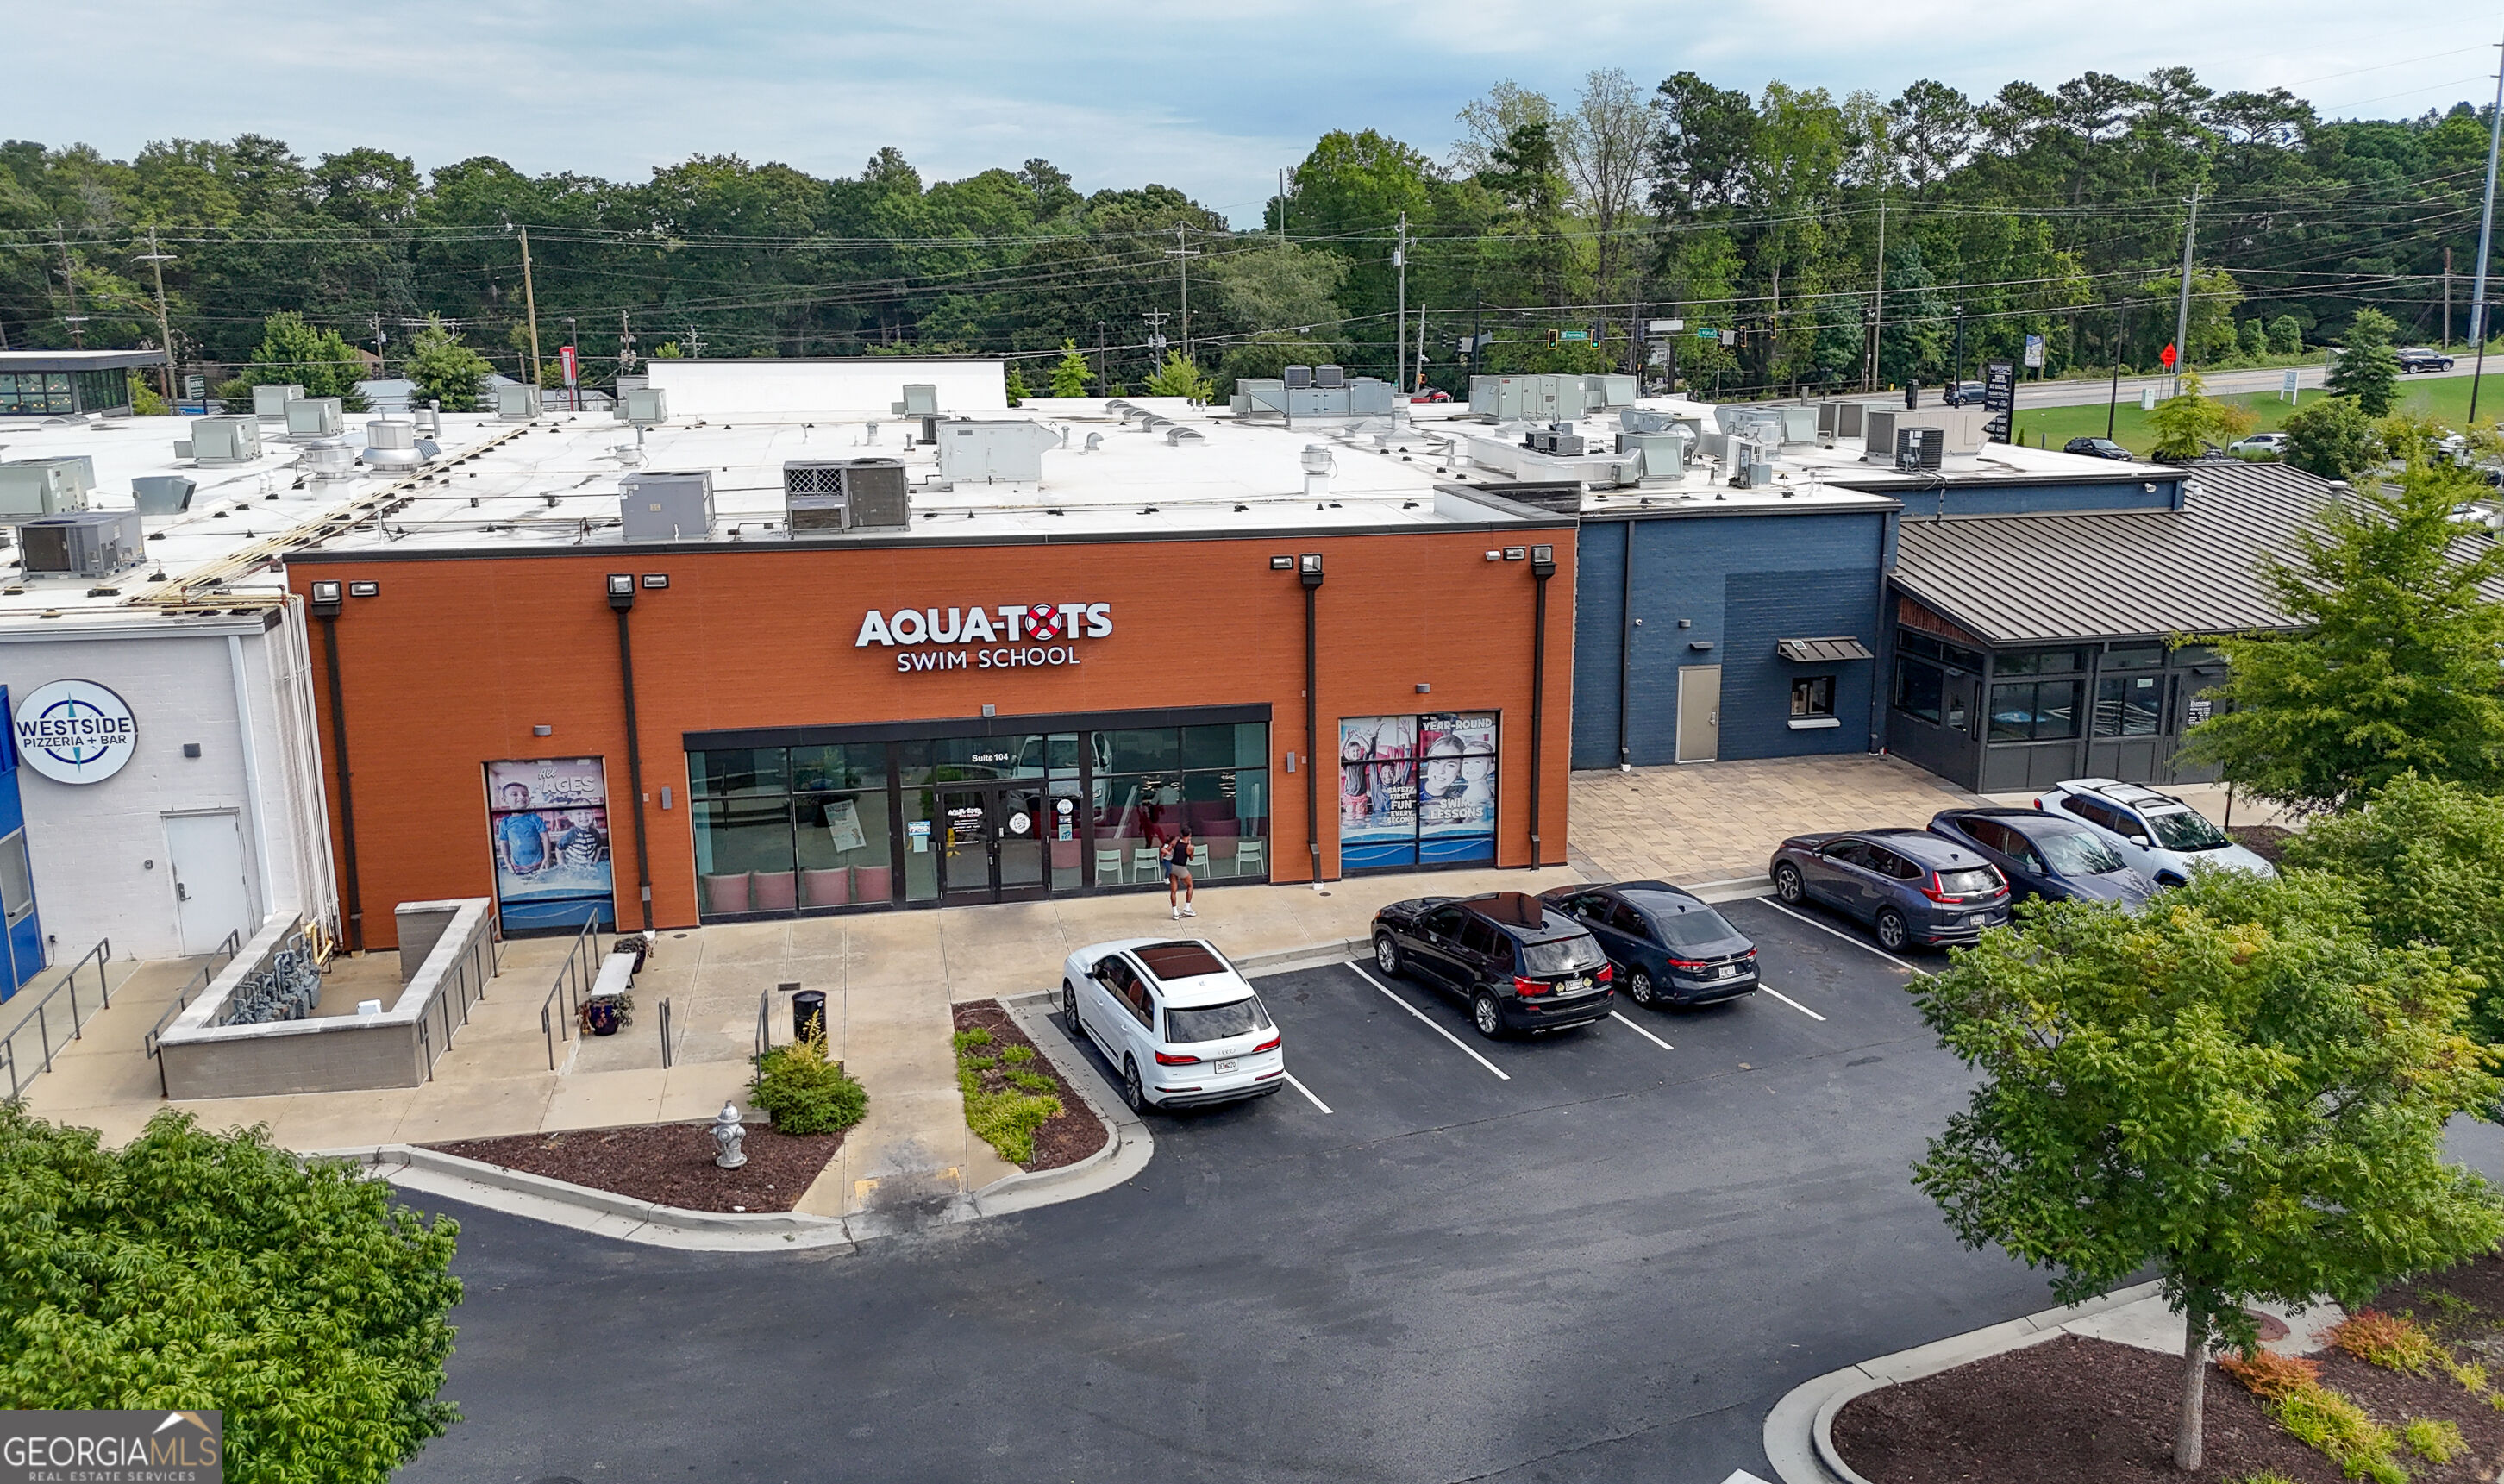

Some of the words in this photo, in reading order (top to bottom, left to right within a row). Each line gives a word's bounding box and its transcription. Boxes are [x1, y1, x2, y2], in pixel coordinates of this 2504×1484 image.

[854, 602, 1113, 647] AQUA-TOTS
[897, 652, 967, 673] SWIM
[978, 646, 1080, 669] SCHOOL
[16, 717, 131, 736] WESTSIDE
[1422, 717, 1493, 732] YEAR-ROUND
[23, 736, 84, 748] PIZZERIA
[87, 736, 97, 745] +
[101, 735, 127, 745] BAR
[541, 775, 595, 793] AGES
[1391, 799, 1412, 810] FUN
[1439, 798, 1470, 809] SWIM
[1430, 807, 1484, 819] LESSONS
